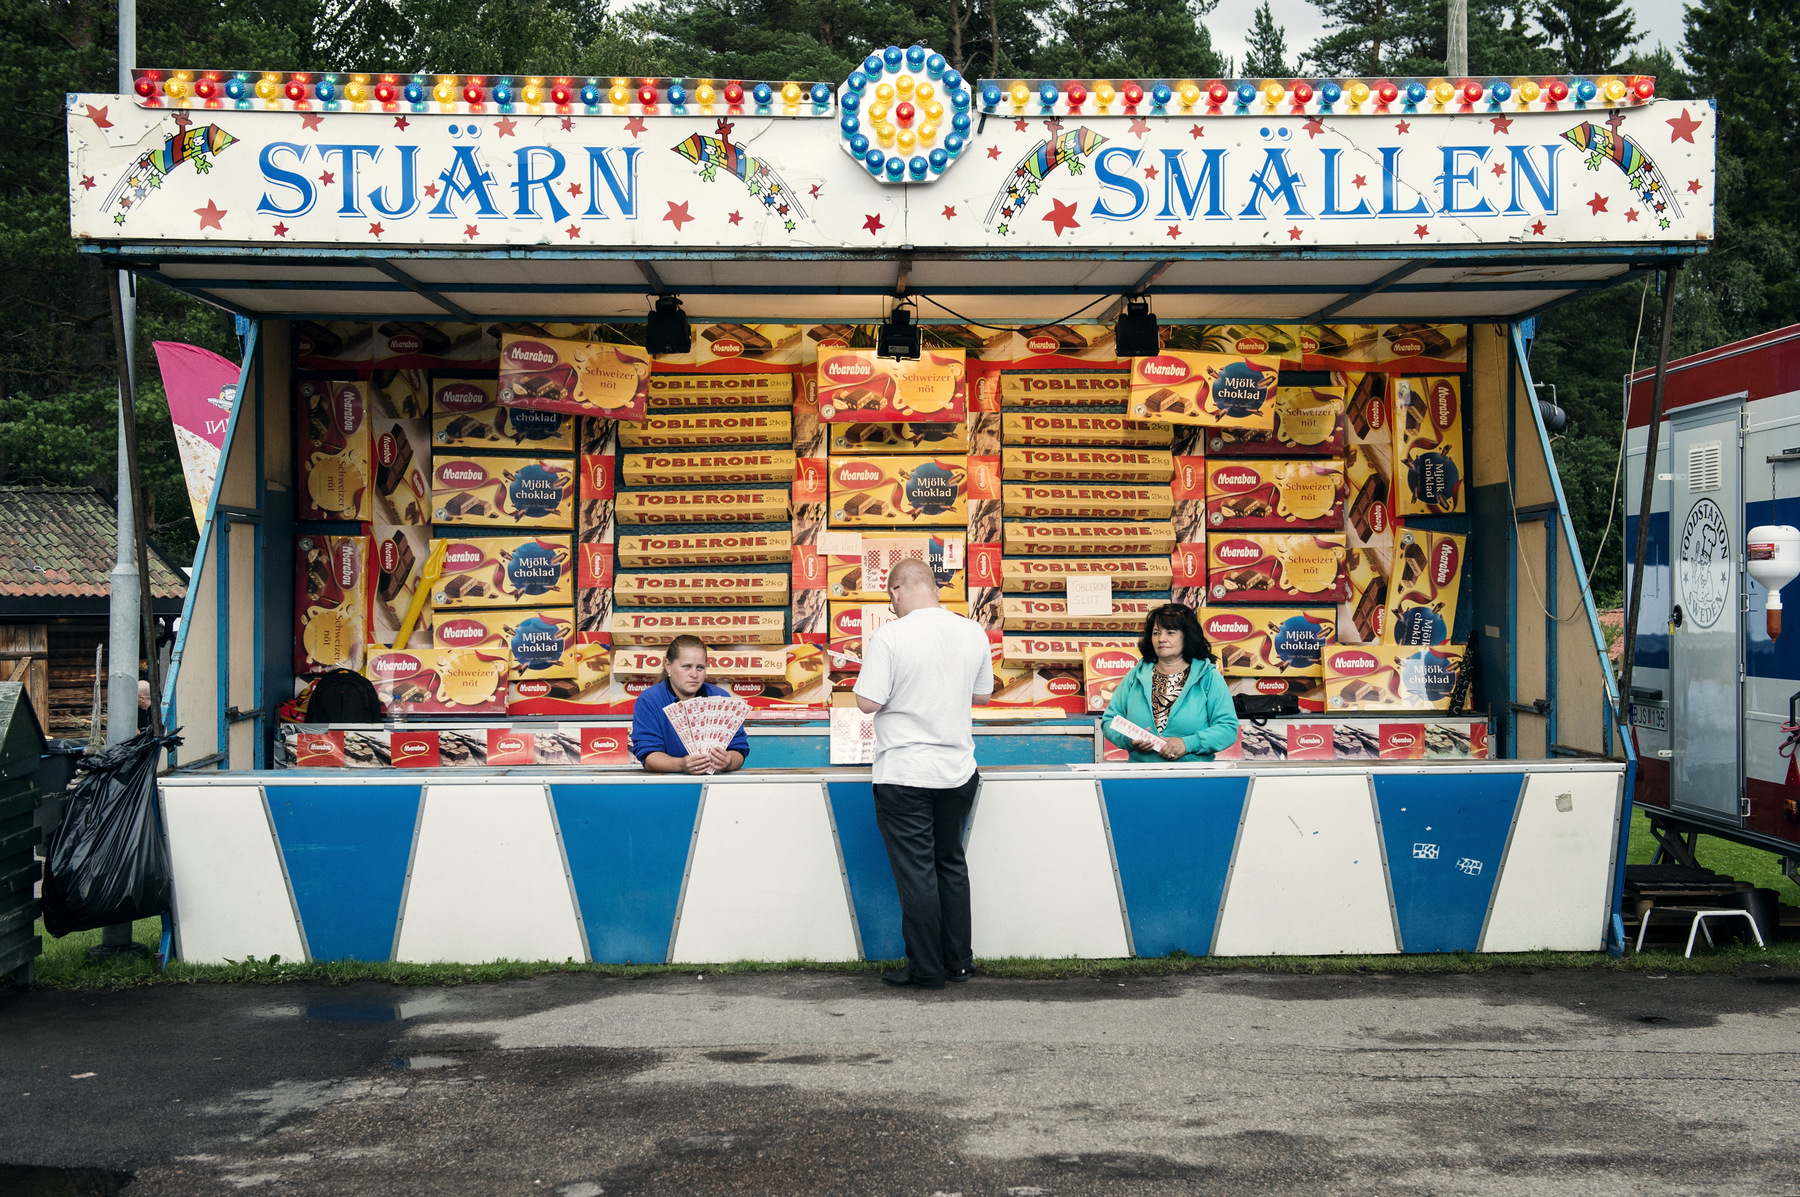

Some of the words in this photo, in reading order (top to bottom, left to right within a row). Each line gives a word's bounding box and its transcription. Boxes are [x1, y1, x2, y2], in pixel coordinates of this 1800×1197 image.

[256, 124, 644, 224] STJÄRN
[1090, 126, 1565, 221] SMÄLLEN
[713, 344, 740, 353] Marabou
[1029, 341, 1056, 350] Marabou
[1393, 343, 1421, 352] Marabou
[511, 347, 554, 364] Marabou
[584, 366, 635, 381] Schweizer
[829, 362, 871, 376] Marabou
[1145, 362, 1186, 376] Marabou
[901, 373, 951, 382] Schweizer
[1225, 377, 1256, 389] Mjölk
[600, 380, 617, 390] nöt
[650, 379, 769, 390] OBLERONE
[918, 383, 934, 393] nöt
[1019, 378, 1130, 391] TOBLERON
[443, 391, 483, 403] Marabou
[1218, 389, 1260, 400] choklad
[1021, 397, 1128, 407] TOBLERON
[1438, 386, 1449, 426] Marabou
[344, 391, 356, 431] Marabou
[1286, 408, 1331, 417] Schweizer
[1371, 400, 1379, 428] Marabou
[516, 412, 557, 423] choklad
[1301, 418, 1316, 427] nöt
[1022, 416, 1150, 430] TOBLERONE
[1151, 423, 1170, 431] 2kg
[637, 435, 768, 445] TOBLERONE
[1021, 436, 1149, 446] TOBLERONE
[383, 435, 392, 463] Marabou
[643, 456, 772, 469] TOBLERONE
[1021, 450, 1150, 464] TOBLERONE
[1151, 457, 1170, 465] 2kg
[443, 468, 483, 480] Marabou
[642, 473, 773, 484] TOBLERONE
[840, 469, 880, 481] Marabou
[1022, 470, 1149, 481] TOBLERONE
[1217, 473, 1257, 485] Marabou
[1424, 458, 1435, 498] choklad
[1435, 463, 1445, 493] Mjölk
[327, 476, 335, 492] nöt
[338, 461, 347, 508] Schweizer
[521, 479, 551, 490] Mjölk
[917, 477, 946, 488] Mjölk
[1285, 482, 1332, 491] Schweizer
[515, 490, 556, 500] choklad
[912, 488, 951, 498] choklad
[1021, 487, 1150, 500] TOBLERONE
[1151, 493, 1170, 501] 2kg
[1301, 493, 1316, 502] nöt
[635, 494, 764, 506] TOBLERONE
[1022, 506, 1149, 517] TOBLERONE
[634, 512, 764, 523] TOBLERONE
[1374, 504, 1382, 531] Marabou
[1023, 526, 1152, 537] TOBLERONE
[1682, 503, 1728, 561] FOODSTATION
[638, 537, 767, 550] TOBLERONE
[1024, 543, 1152, 553] TOBLERONE
[385, 542, 393, 570] Marabou
[1220, 546, 1259, 558] Marabou
[519, 557, 549, 568] Mjölk
[637, 554, 768, 565] TOBLERONE
[1288, 555, 1334, 564] Schweizer
[1438, 543, 1453, 583] Marabou
[342, 546, 354, 586] Marabou
[1020, 562, 1148, 573] TOBLERONE
[1150, 564, 1168, 572] 2kg
[1303, 565, 1319, 574] nöt
[514, 567, 555, 577] choklad
[635, 577, 763, 589] TOBLERONE
[1068, 580, 1110, 593] TOBLERONE
[634, 595, 764, 605] TOBLERONE
[1074, 595, 1101, 605] SLUT
[1687, 590, 1723, 622] SWEDEN
[631, 615, 760, 628] TOBLERONE
[761, 617, 780, 626] 2kg
[1210, 620, 1249, 633] Marabou
[443, 626, 484, 638] Marabou
[1412, 612, 1422, 645] chokla
[334, 614, 343, 661] Schweizer
[522, 632, 552, 644] Mjölk
[630, 634, 760, 645] TOBRONE
[1286, 630, 1315, 641] Mjölk
[517, 643, 558, 653] choklad
[1280, 640, 1320, 650] choklad
[376, 660, 418, 671] Marabou
[634, 654, 762, 669] TORONE
[764, 660, 782, 669] 2kg
[1096, 658, 1135, 669] Marabou
[1335, 657, 1375, 668] Marabou
[447, 669, 495, 677] Schweizer
[1413, 665, 1443, 675] Mjölk
[462, 678, 479, 687] nöt
[1409, 675, 1449, 684] choklad
[519, 684, 547, 692] Marabou
[733, 683, 761, 692] Marabou
[1049, 681, 1077, 690] Marabou
[1258, 681, 1285, 690] Marabou
[1633, 706, 1647, 724] BJS
[1652, 709, 1665, 727] 135
[403, 744, 426, 752] Marabou
[499, 742, 522, 750] Marabou
[593, 741, 615, 749] Marabou
